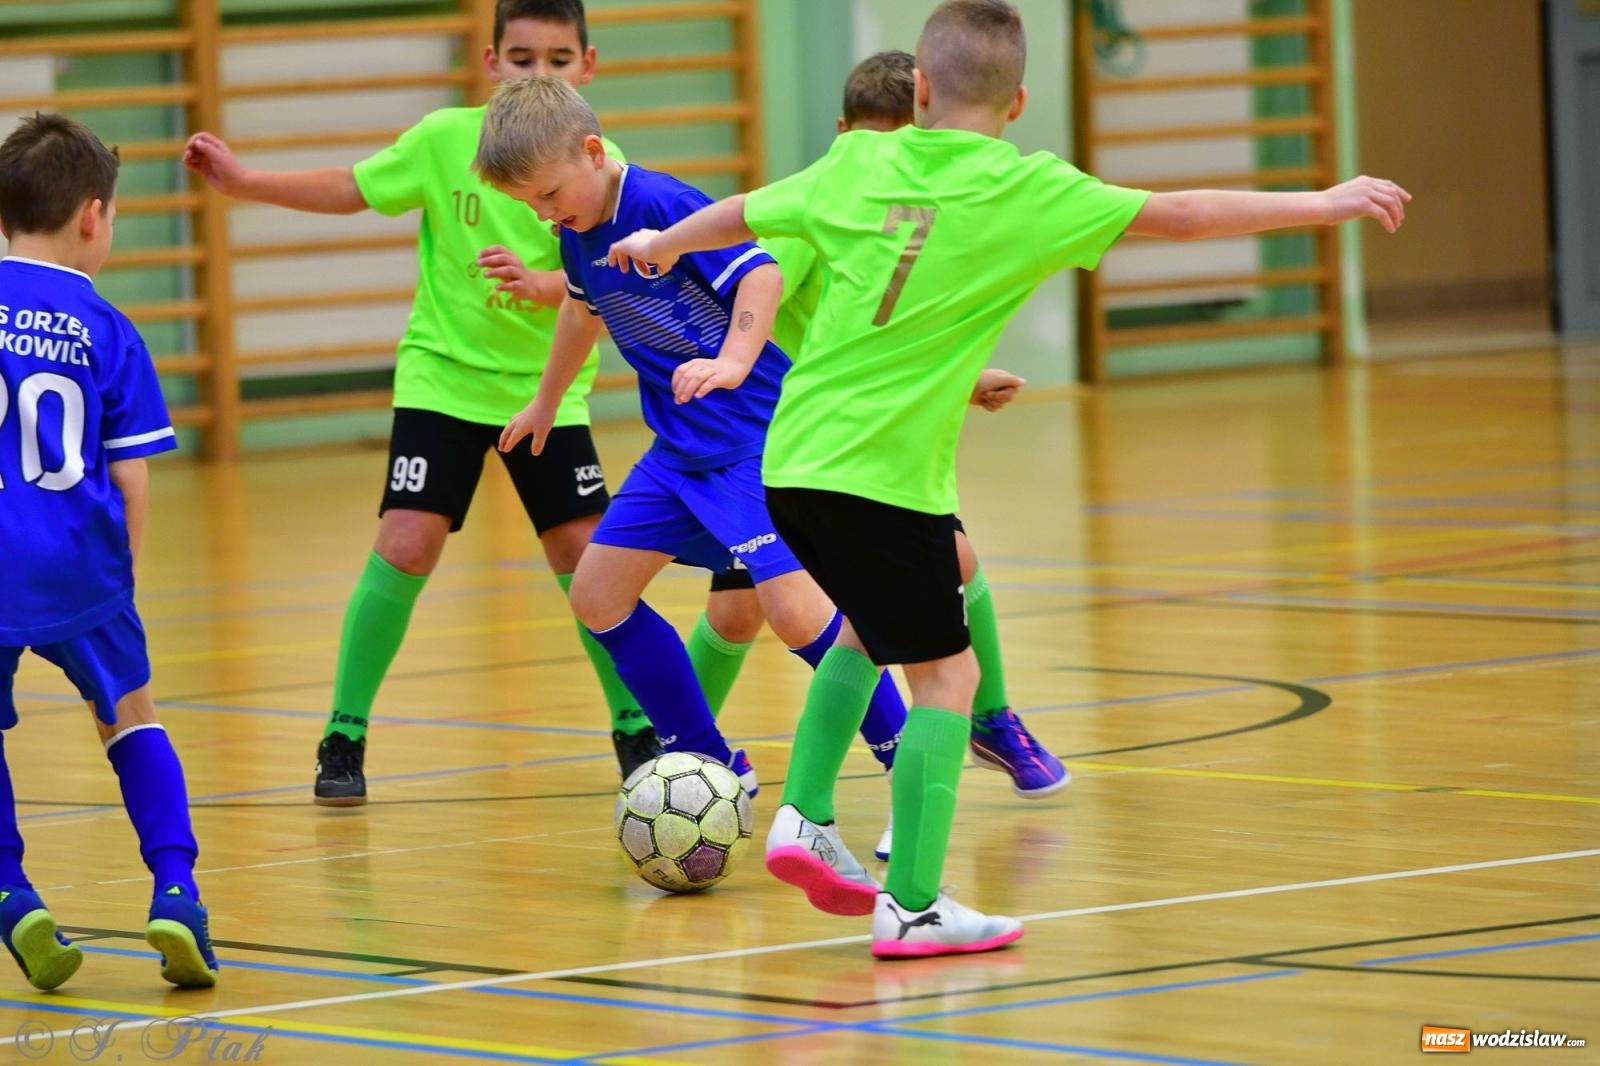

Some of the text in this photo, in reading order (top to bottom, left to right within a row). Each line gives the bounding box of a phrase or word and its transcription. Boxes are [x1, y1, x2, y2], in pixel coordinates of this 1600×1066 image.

[450, 190, 481, 227] 10
[871, 204, 937, 327] 7
[14, 308, 93, 347] ORZEŁ
[0, 371, 85, 491] 0
[391, 455, 428, 493] 99
[728, 532, 777, 554] regio
